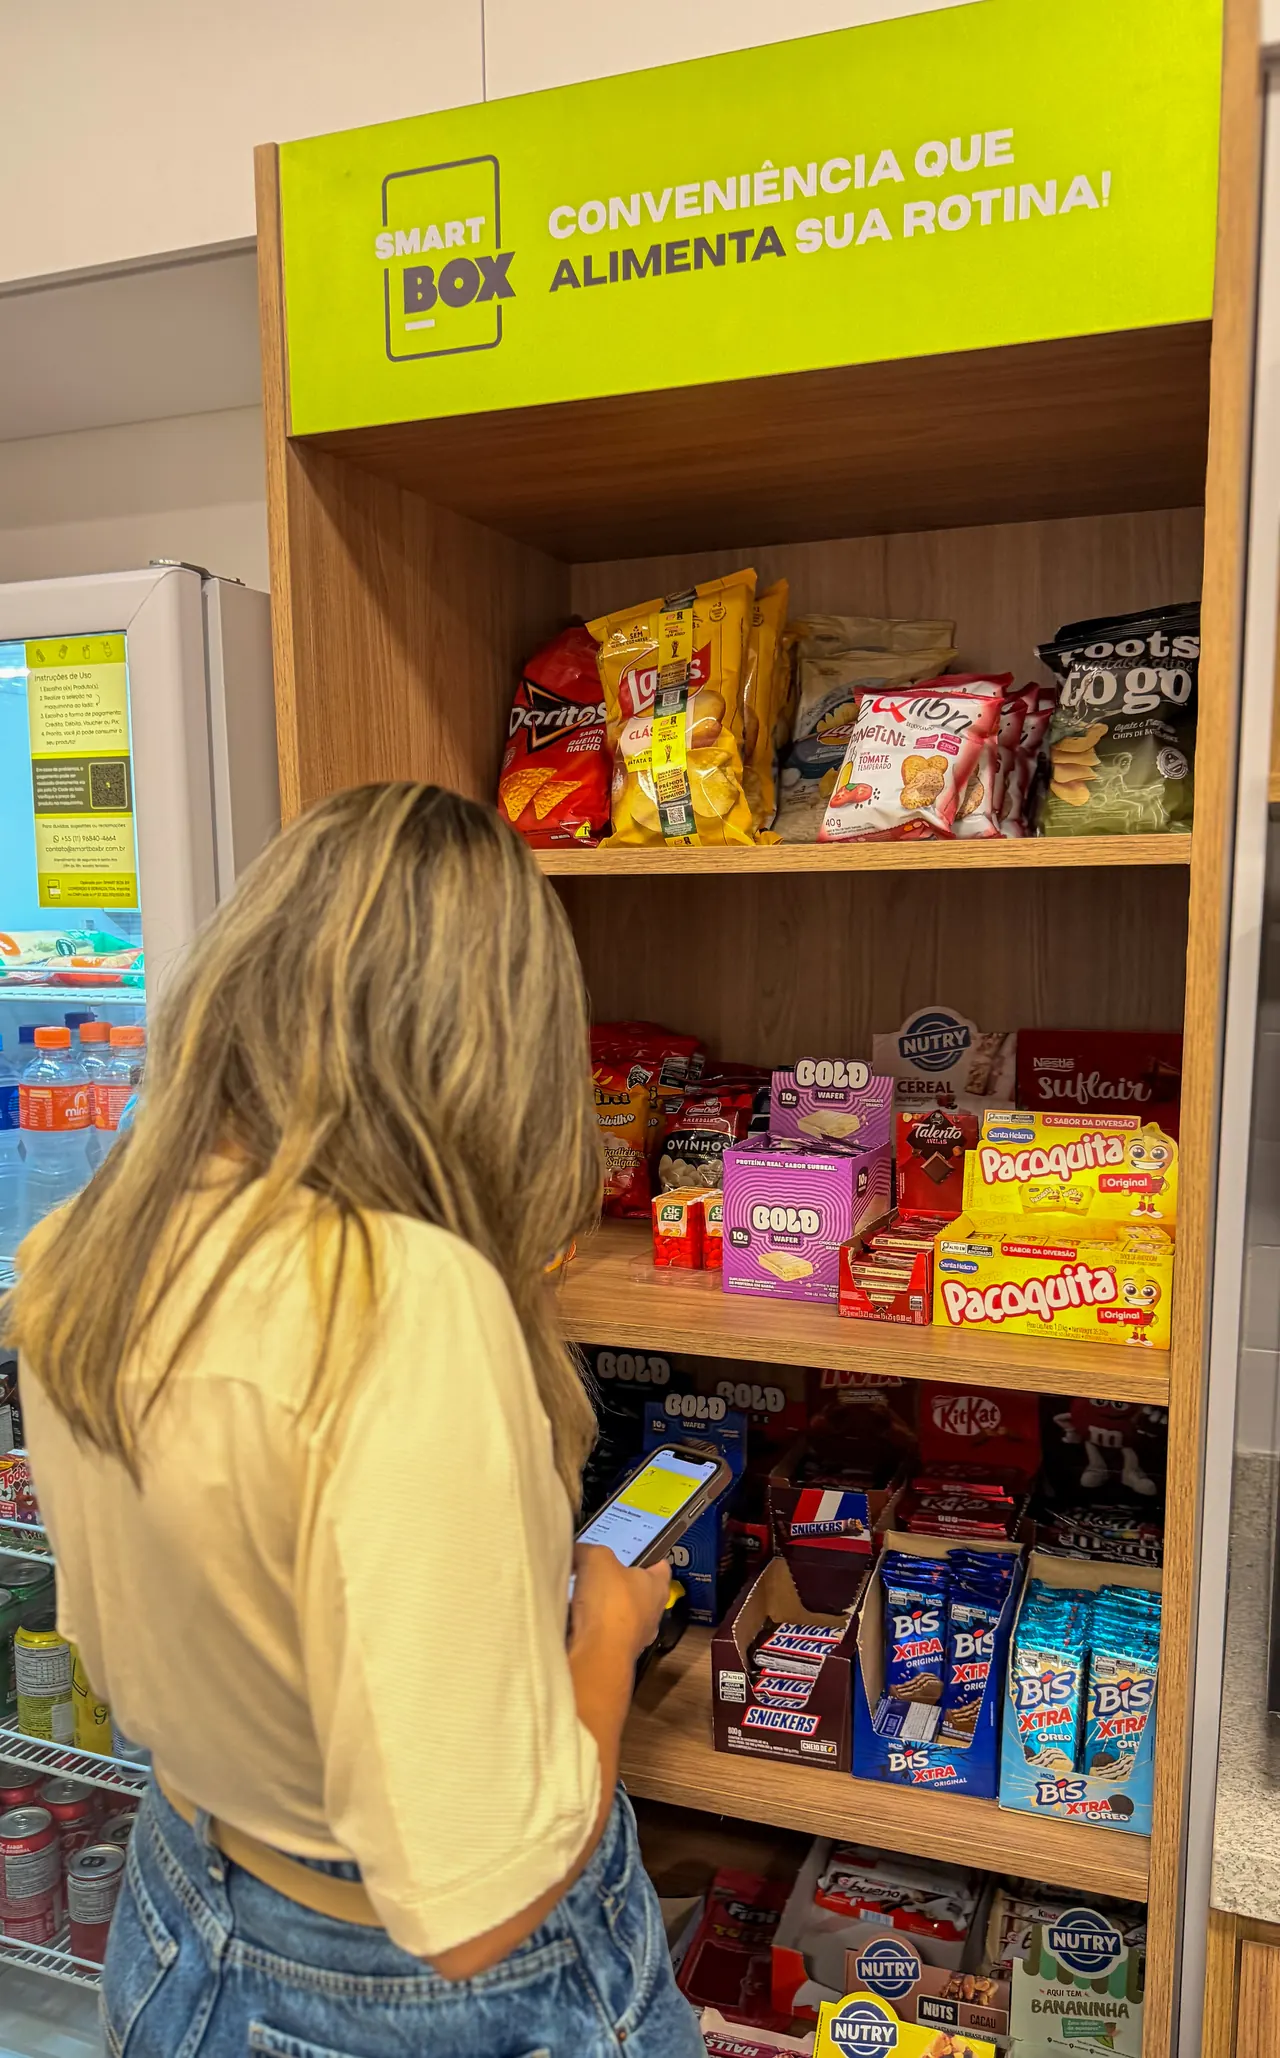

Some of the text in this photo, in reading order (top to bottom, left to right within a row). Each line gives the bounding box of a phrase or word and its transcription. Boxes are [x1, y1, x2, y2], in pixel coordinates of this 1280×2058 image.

[548, 128, 1014, 240] CONVENIÊNCIA QUE
[375, 216, 486, 260] SMART
[549, 171, 1112, 293] ALIMENTA SUA ROTINA!
[403, 251, 516, 315] BOX
[1058, 631, 1200, 668] roots
[34, 671, 92, 682] Instruções de Uso
[1060, 667, 1192, 715] to go
[509, 701, 608, 738] Doritos
[568, 736, 602, 746] QUEIJO
[857, 763, 892, 772] TEMPERADO
[859, 755, 890, 765] TOMATE
[903, 1029, 968, 1055] NUTRY
[796, 1059, 869, 1089] BOLD
[817, 1091, 845, 1100] WAFER
[897, 1081, 955, 1094] CEREAL
[1038, 1072, 1152, 1105] suflair
[911, 1123, 962, 1140] Talento
[1053, 1118, 1080, 1126] SABOR
[1095, 1119, 1135, 1128] DIVERSÃO
[988, 1131, 1034, 1140] Santa Helena
[667, 1140, 730, 1151] OVINHOS
[735, 1158, 766, 1167] PROTEÍNA
[784, 1161, 806, 1169] SABOR
[981, 1133, 1124, 1183] Paçoquita
[1107, 1178, 1148, 1189] Original
[663, 1212, 680, 1221] tac
[667, 1206, 682, 1214] tic
[711, 1212, 723, 1221] ta
[714, 1206, 723, 1214] ti
[752, 1205, 820, 1235] BOLD
[773, 1236, 799, 1244] WAFER
[1009, 1246, 1032, 1255] SABOR
[1043, 1248, 1076, 1258] DIVERSÃO
[943, 1265, 1116, 1323] Paçoquita
[1104, 1310, 1141, 1320] Original
[596, 1351, 671, 1385] BOLD
[716, 1380, 786, 1413] BOLD
[664, 1393, 727, 1421] BOLD
[940, 1397, 998, 1434] KitKat
[682, 1420, 706, 1429] WAFER
[791, 1521, 843, 1535] SNICKERS
[892, 1637, 944, 1663] XTRA
[906, 1654, 944, 1668] ORIGINAL
[950, 1661, 990, 1685] XTR
[747, 1708, 816, 1733] SNICKERS
[1019, 1707, 1073, 1733] XTRA
[1096, 1714, 1147, 1740] XTRA
[1037, 1732, 1072, 1742] OREO
[912, 1764, 957, 1784] XTRA
[934, 1777, 968, 1787] ORIGINAL
[1066, 1799, 1112, 1816] XTRA
[1086, 1811, 1129, 1821] OREO
[850, 1881, 900, 1899] bueno
[728, 1901, 778, 1924] Fini
[1053, 1931, 1118, 1953] NUTRY
[861, 1960, 917, 1978] NUTRY
[1046, 1988, 1082, 1997] AQUI TEM
[923, 2001, 954, 2021] NUTS
[1031, 1998, 1130, 2019] BANANINHA
[970, 2014, 996, 2029] CACAU
[834, 2021, 895, 2043] NUTRY
[705, 2038, 760, 2057] HALLS
